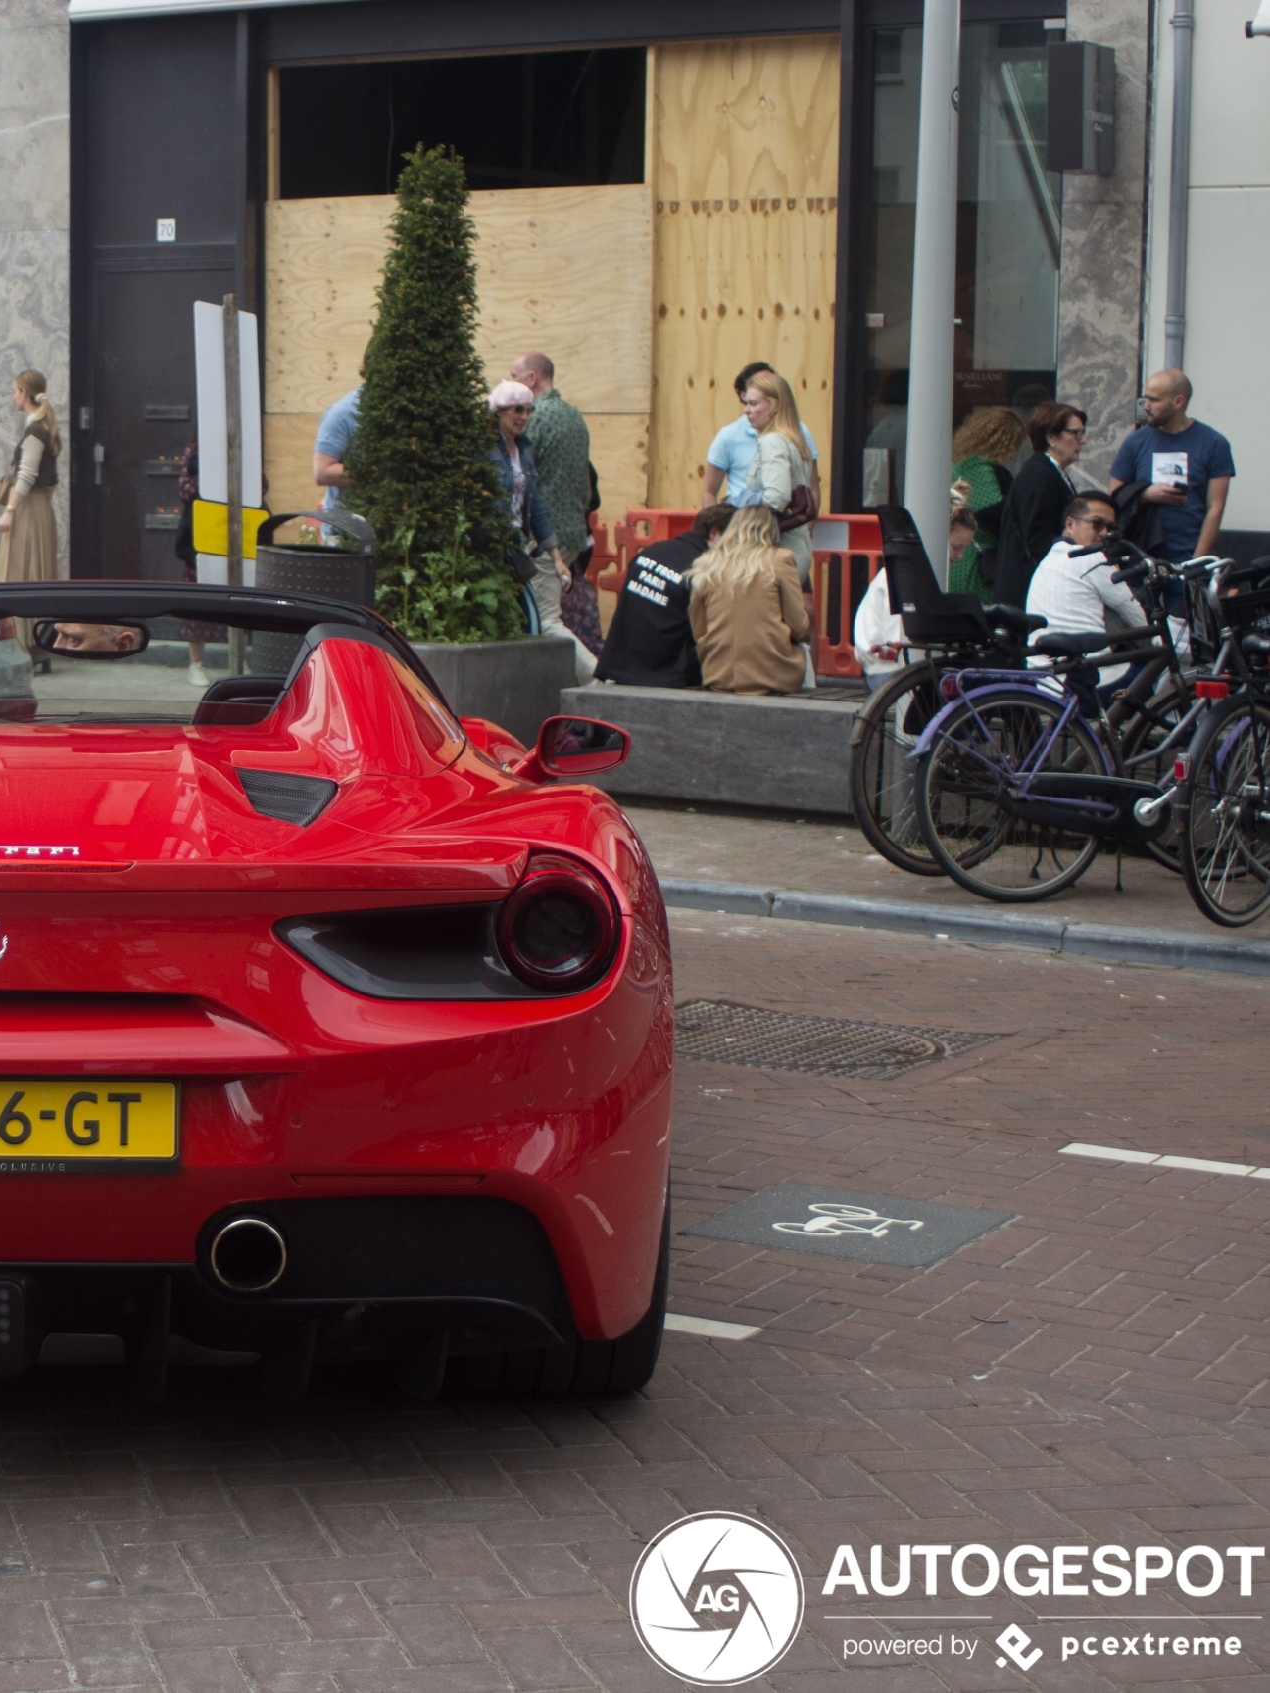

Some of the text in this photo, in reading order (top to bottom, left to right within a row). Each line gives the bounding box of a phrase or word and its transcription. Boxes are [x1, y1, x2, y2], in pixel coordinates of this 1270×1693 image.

[160, 223, 173, 236] 70
[636, 555, 682, 584] NOT FROM
[638, 570, 666, 591] PARIS
